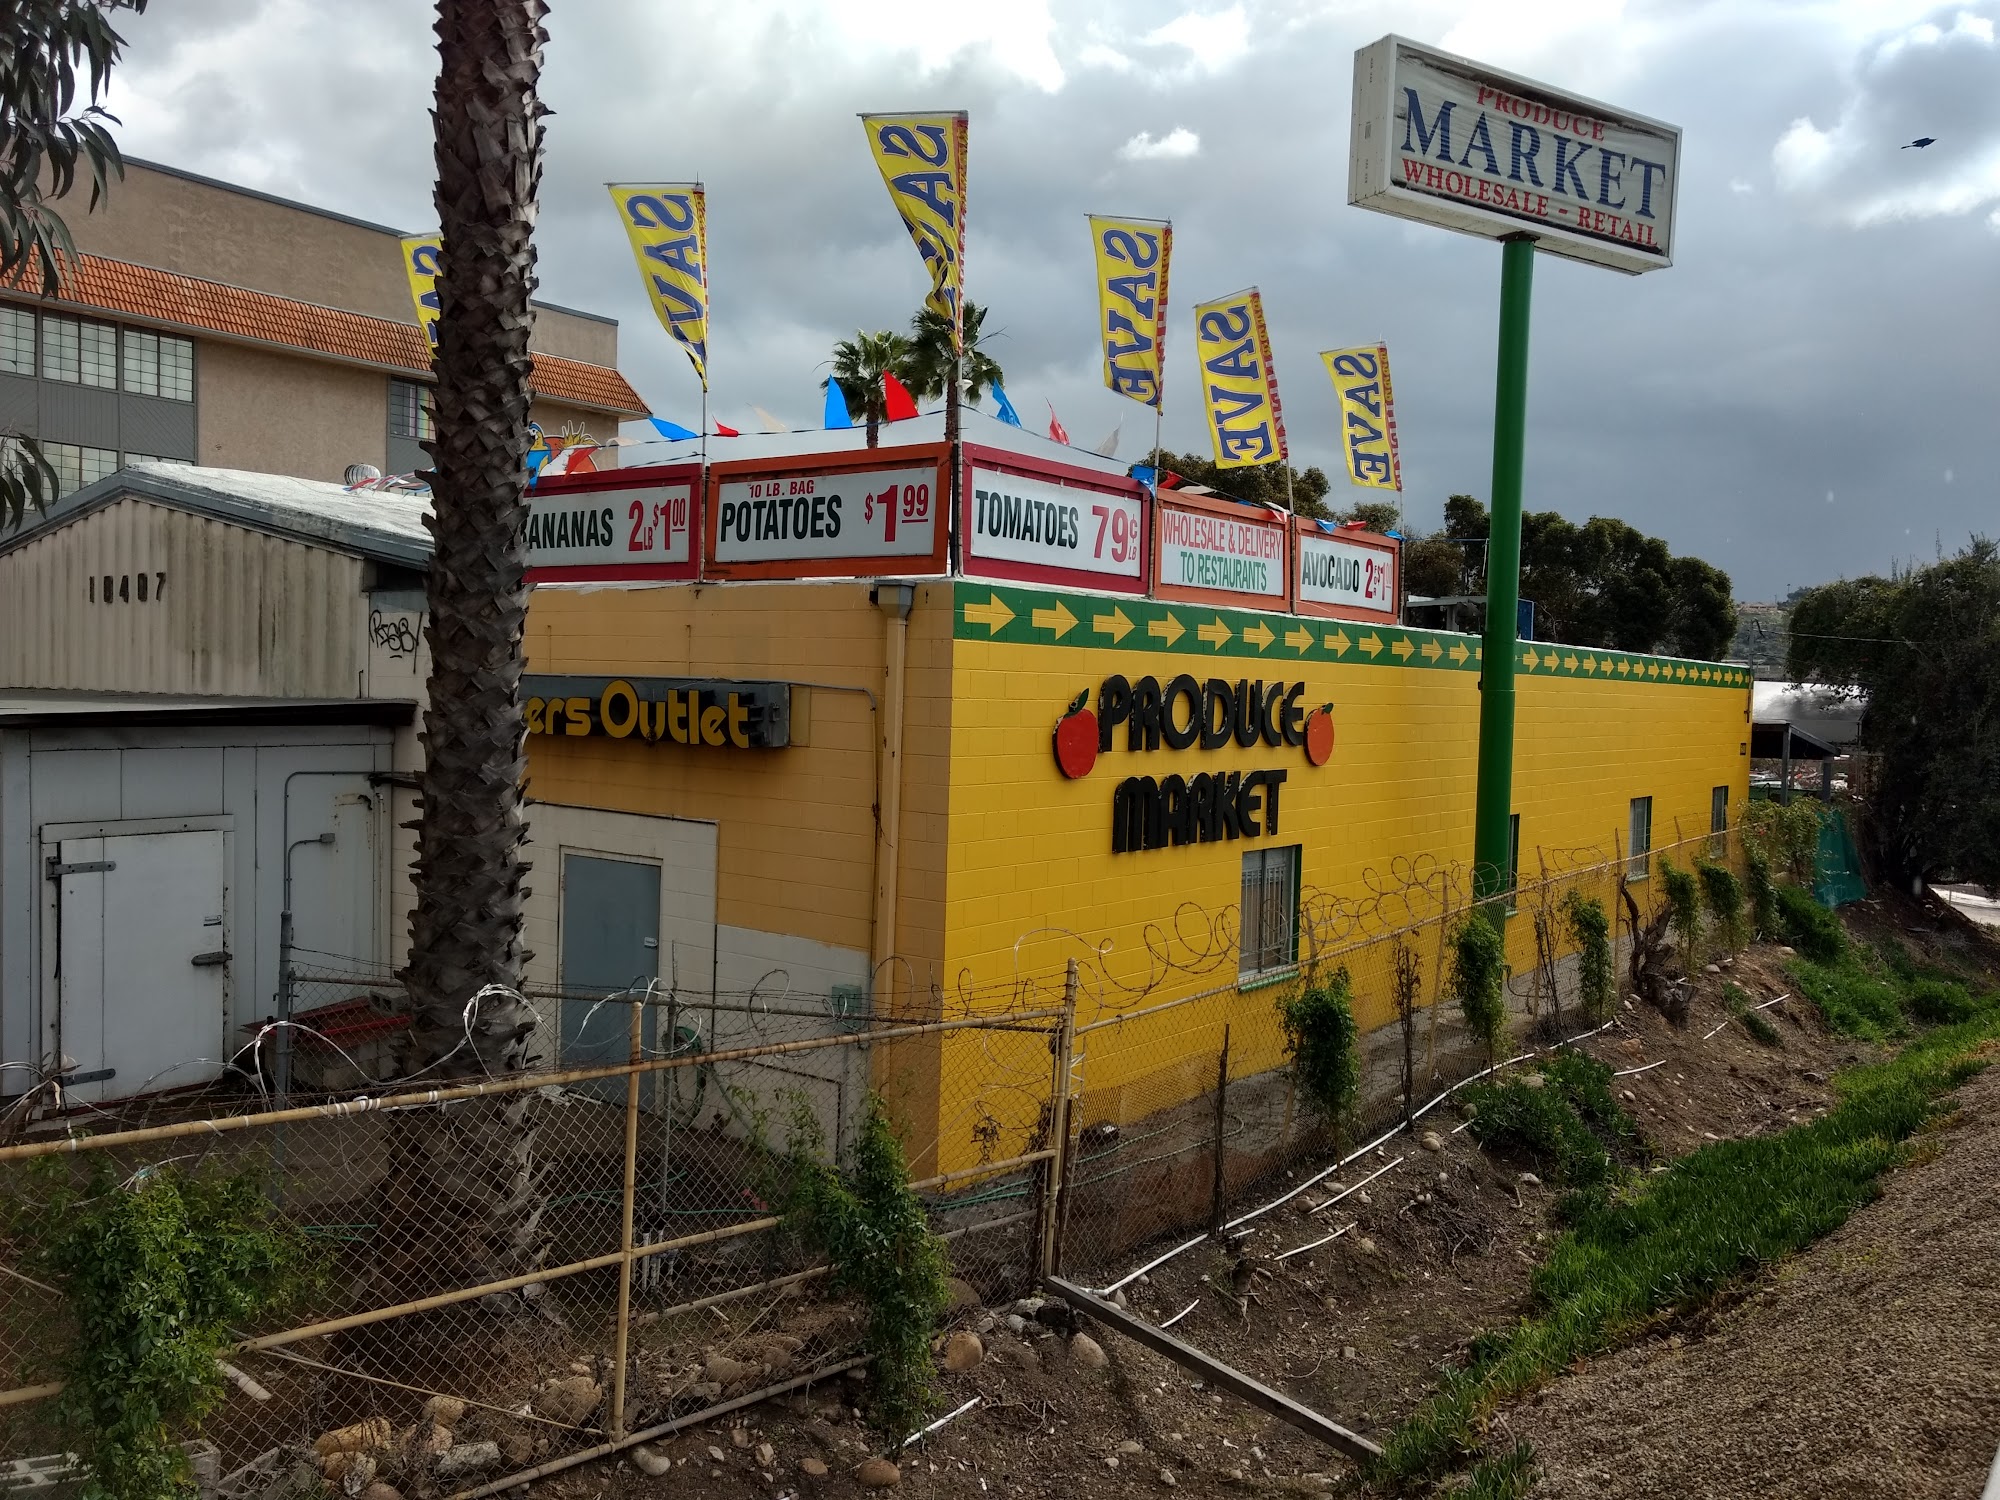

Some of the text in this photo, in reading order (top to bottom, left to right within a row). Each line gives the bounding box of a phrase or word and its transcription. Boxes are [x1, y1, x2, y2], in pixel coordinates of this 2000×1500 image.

[1476, 86, 1605, 142] PRODUCE
[1401, 86, 1666, 219] MARKET
[1402, 158, 1549, 217] WHOLESALE
[1577, 206, 1658, 247] RETAIL
[750, 479, 815, 498] 10 LB. BAG
[720, 494, 842, 542] POTATOES
[975, 489, 1079, 549] TOMATOES
[1163, 511, 1282, 560] WHOLESALE & DELIVERY
[89, 572, 166, 603] 10407
[1180, 551, 1267, 592] TO RESTAURANTS
[1302, 551, 1360, 593] AVOCADO
[1365, 558, 1374, 599] 2
[600, 679, 750, 749] Outlet
[1098, 674, 1305, 752] PRODUCE
[1112, 769, 1288, 853] MARKET
